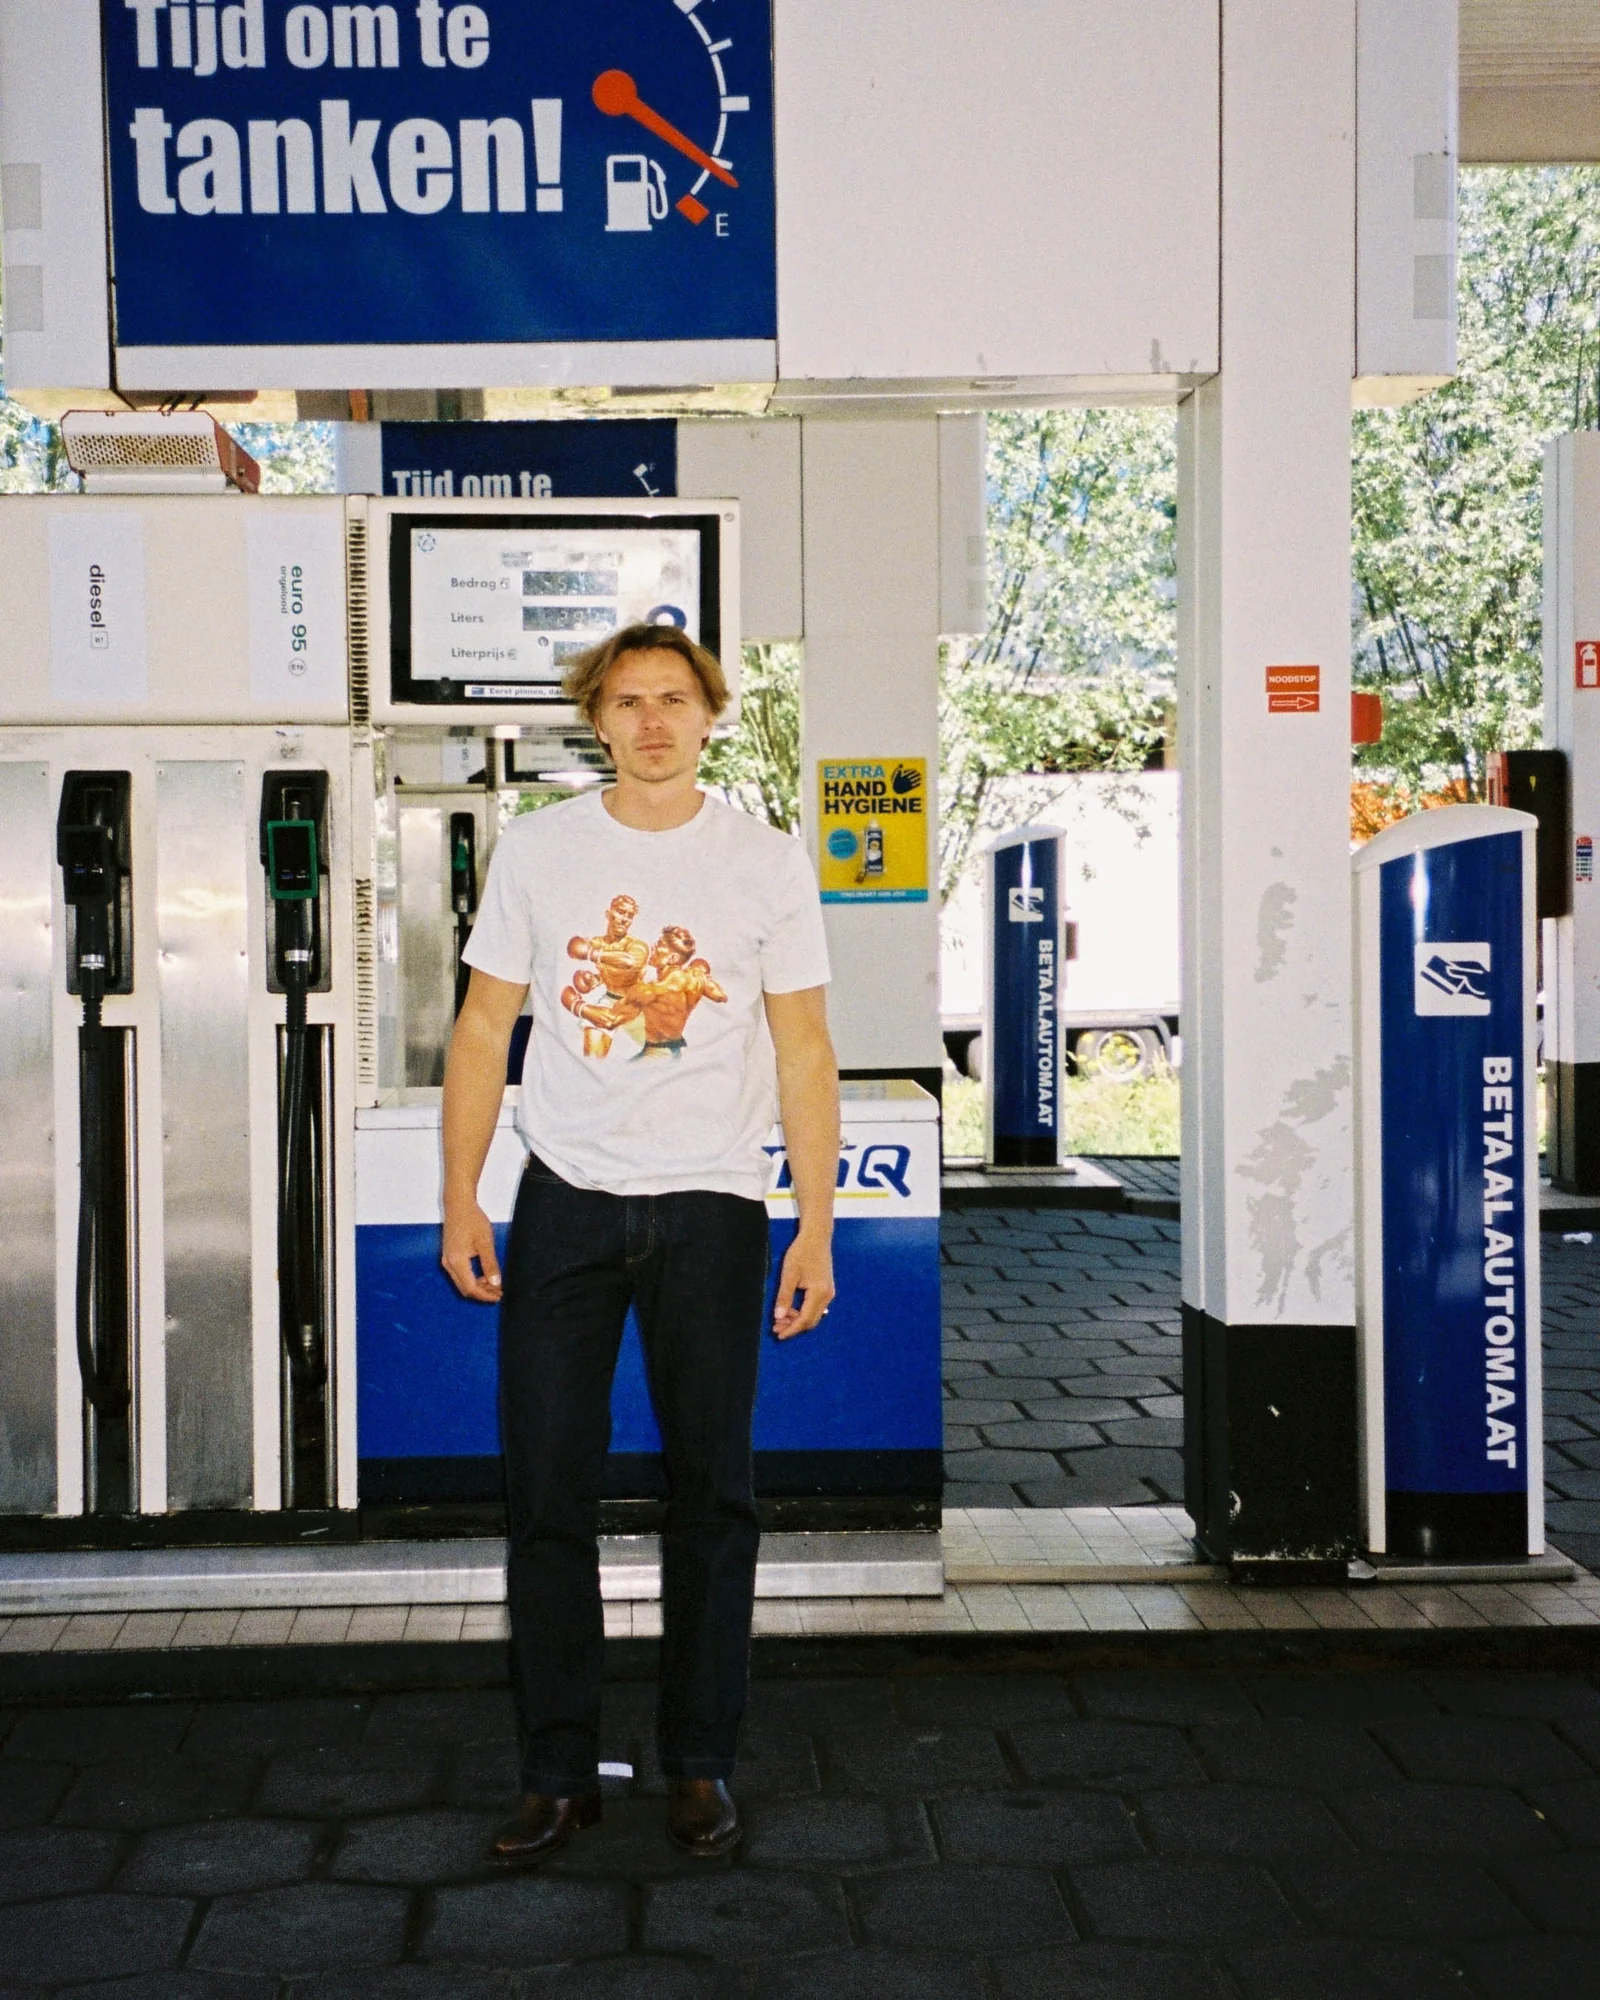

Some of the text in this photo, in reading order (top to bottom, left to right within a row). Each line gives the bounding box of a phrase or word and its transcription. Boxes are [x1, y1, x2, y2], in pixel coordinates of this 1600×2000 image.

[125, 0, 489, 76] Tijd om te
[130, 98, 563, 214] tanken!
[715, 213, 729, 236] E
[462, 474, 511, 497] om
[520, 471, 552, 497] te
[89, 564, 106, 628] diesel
[279, 566, 289, 615] ongelood
[451, 577, 497, 591] Bedrag
[290, 565, 307, 652] euro 95
[451, 613, 484, 624] Liters
[451, 648, 505, 661] Literprijs
[1268, 675, 1317, 683] NOODSTOP
[824, 765, 886, 779] EXTRA
[824, 781, 887, 797] HAND
[824, 798, 922, 814] HYGIENE
[1036, 939, 1054, 1127] BETAALAUTOMAAT
[1482, 1055, 1516, 1470] BETAALAUTOMAAT
